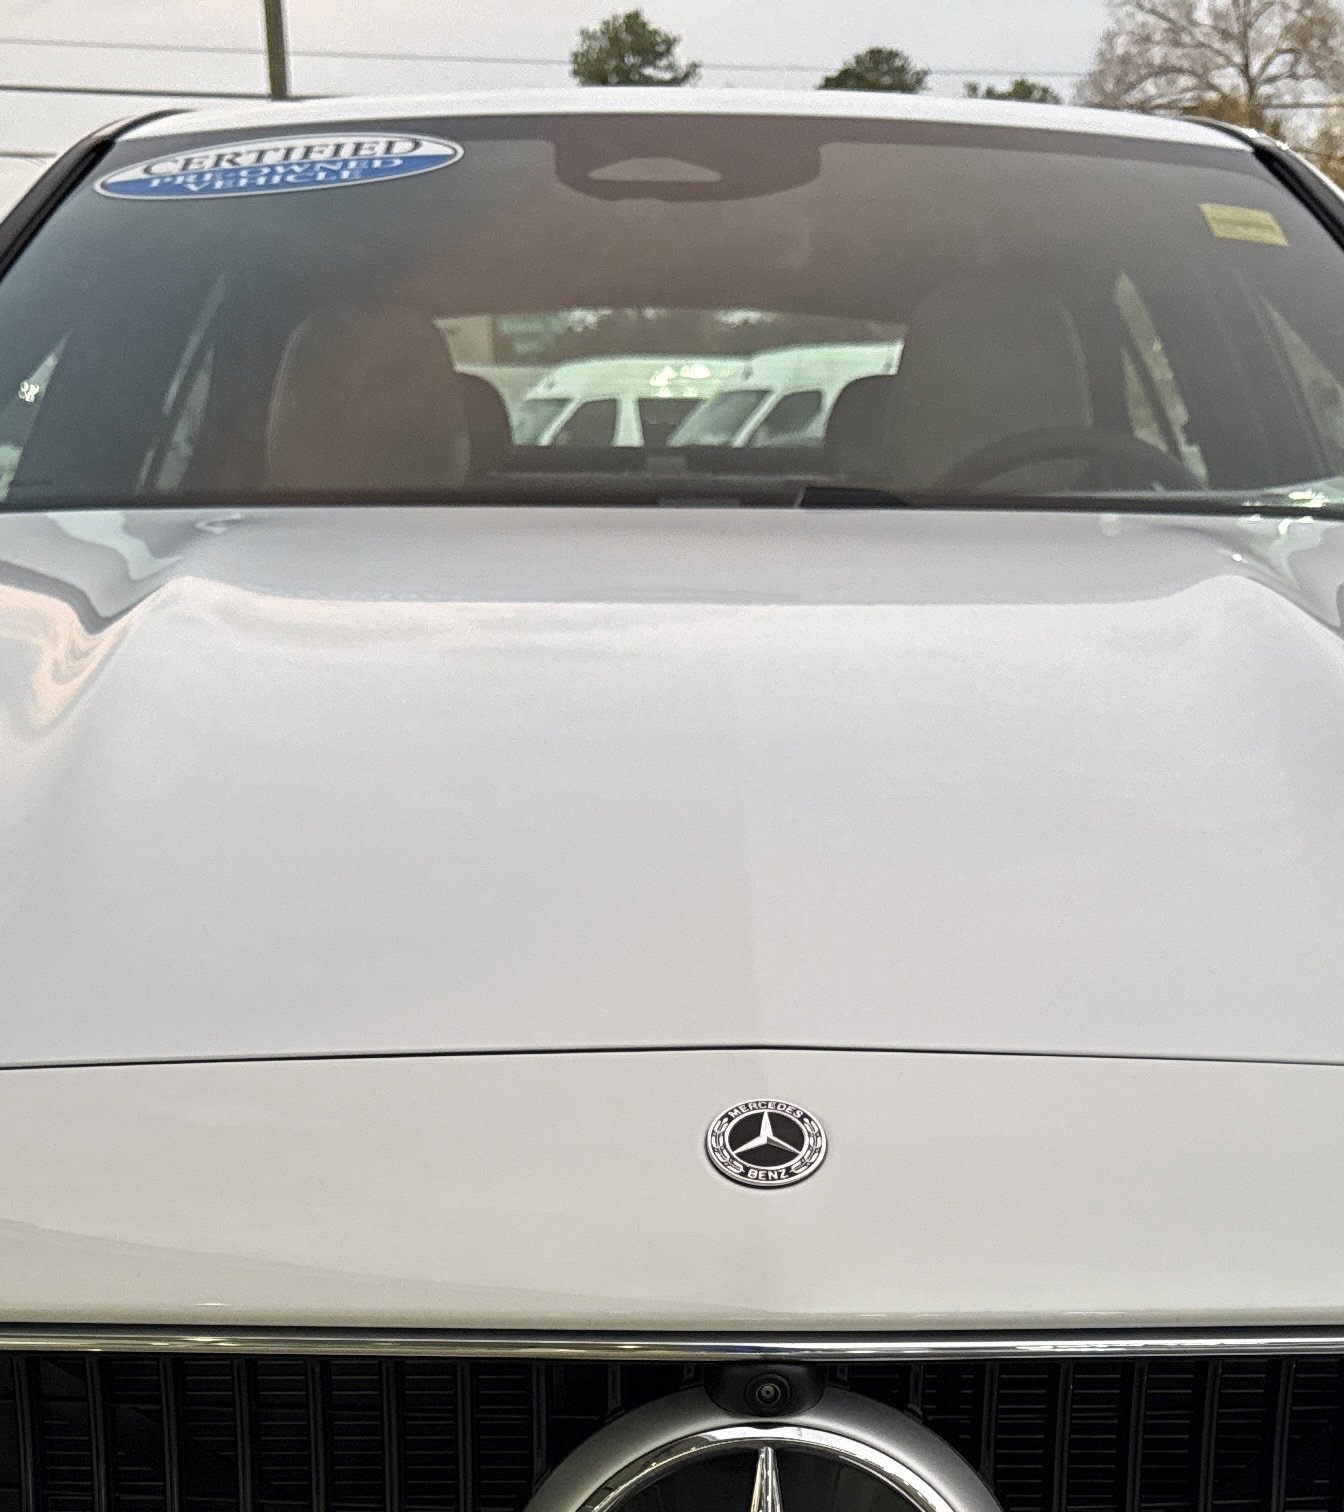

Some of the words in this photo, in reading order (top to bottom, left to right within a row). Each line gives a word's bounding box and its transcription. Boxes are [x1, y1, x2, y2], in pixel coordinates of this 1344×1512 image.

[142, 137, 422, 176] CERTIFIED
[184, 169, 363, 192] VEHICLE
[727, 1101, 804, 1119] MERCEDES
[747, 1169, 789, 1181] BENZ
